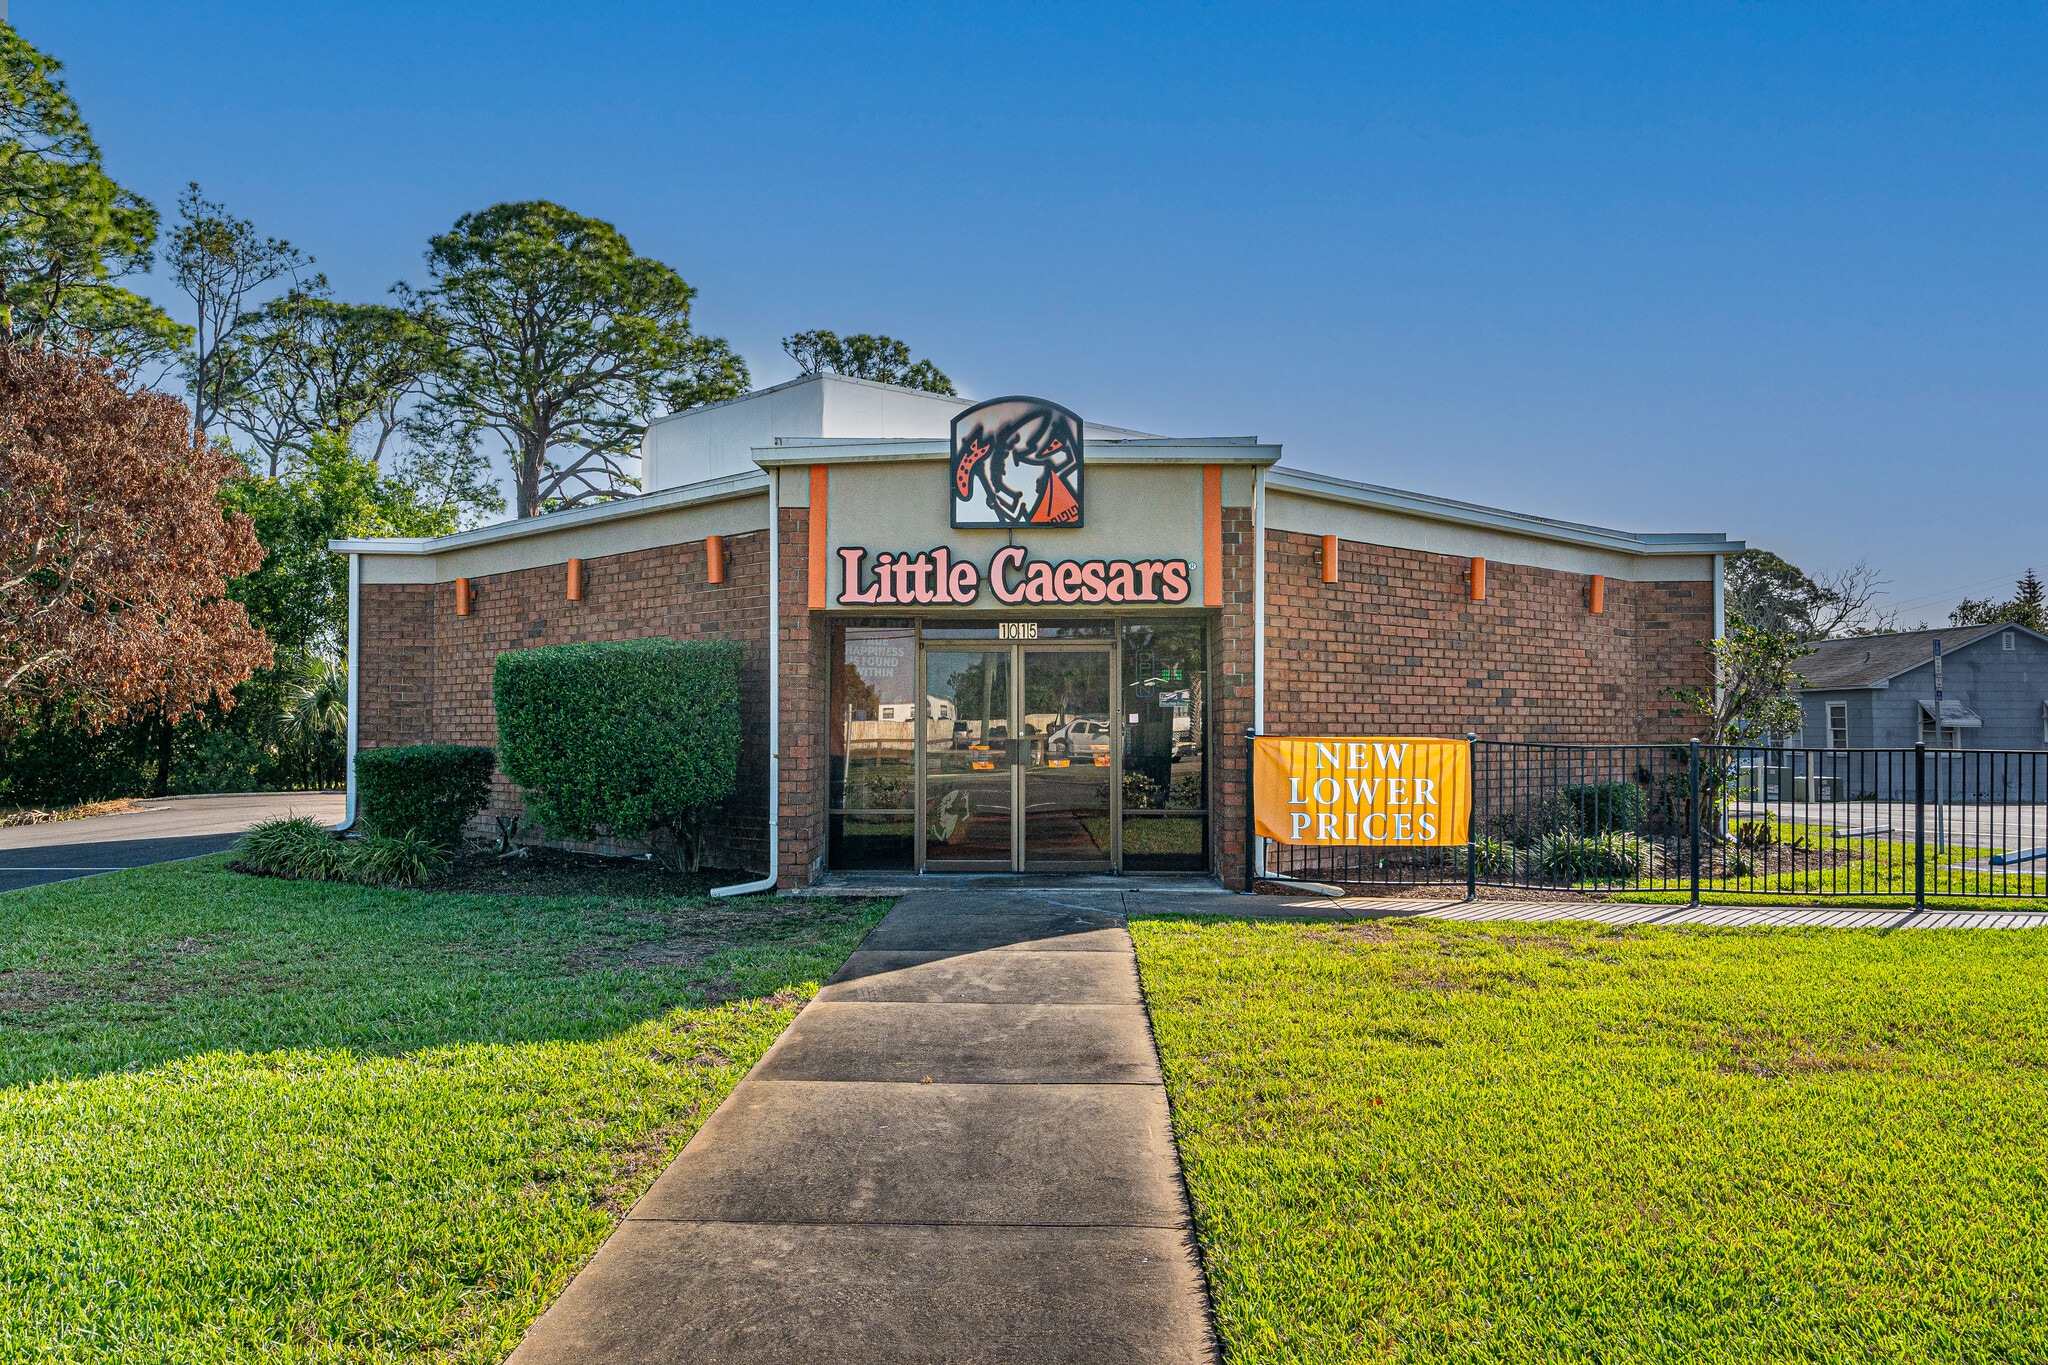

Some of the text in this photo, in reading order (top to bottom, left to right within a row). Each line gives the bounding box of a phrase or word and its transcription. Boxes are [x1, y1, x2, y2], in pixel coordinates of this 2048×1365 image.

[837, 545, 1192, 605] Little Caesars
[1001, 623, 1037, 638] 1015
[856, 667, 894, 677] WITHIN
[862, 656, 899, 667] FOUND
[1314, 742, 1409, 770] NEW
[1288, 777, 1438, 805] LOWER
[1290, 812, 1436, 841] PRICES
